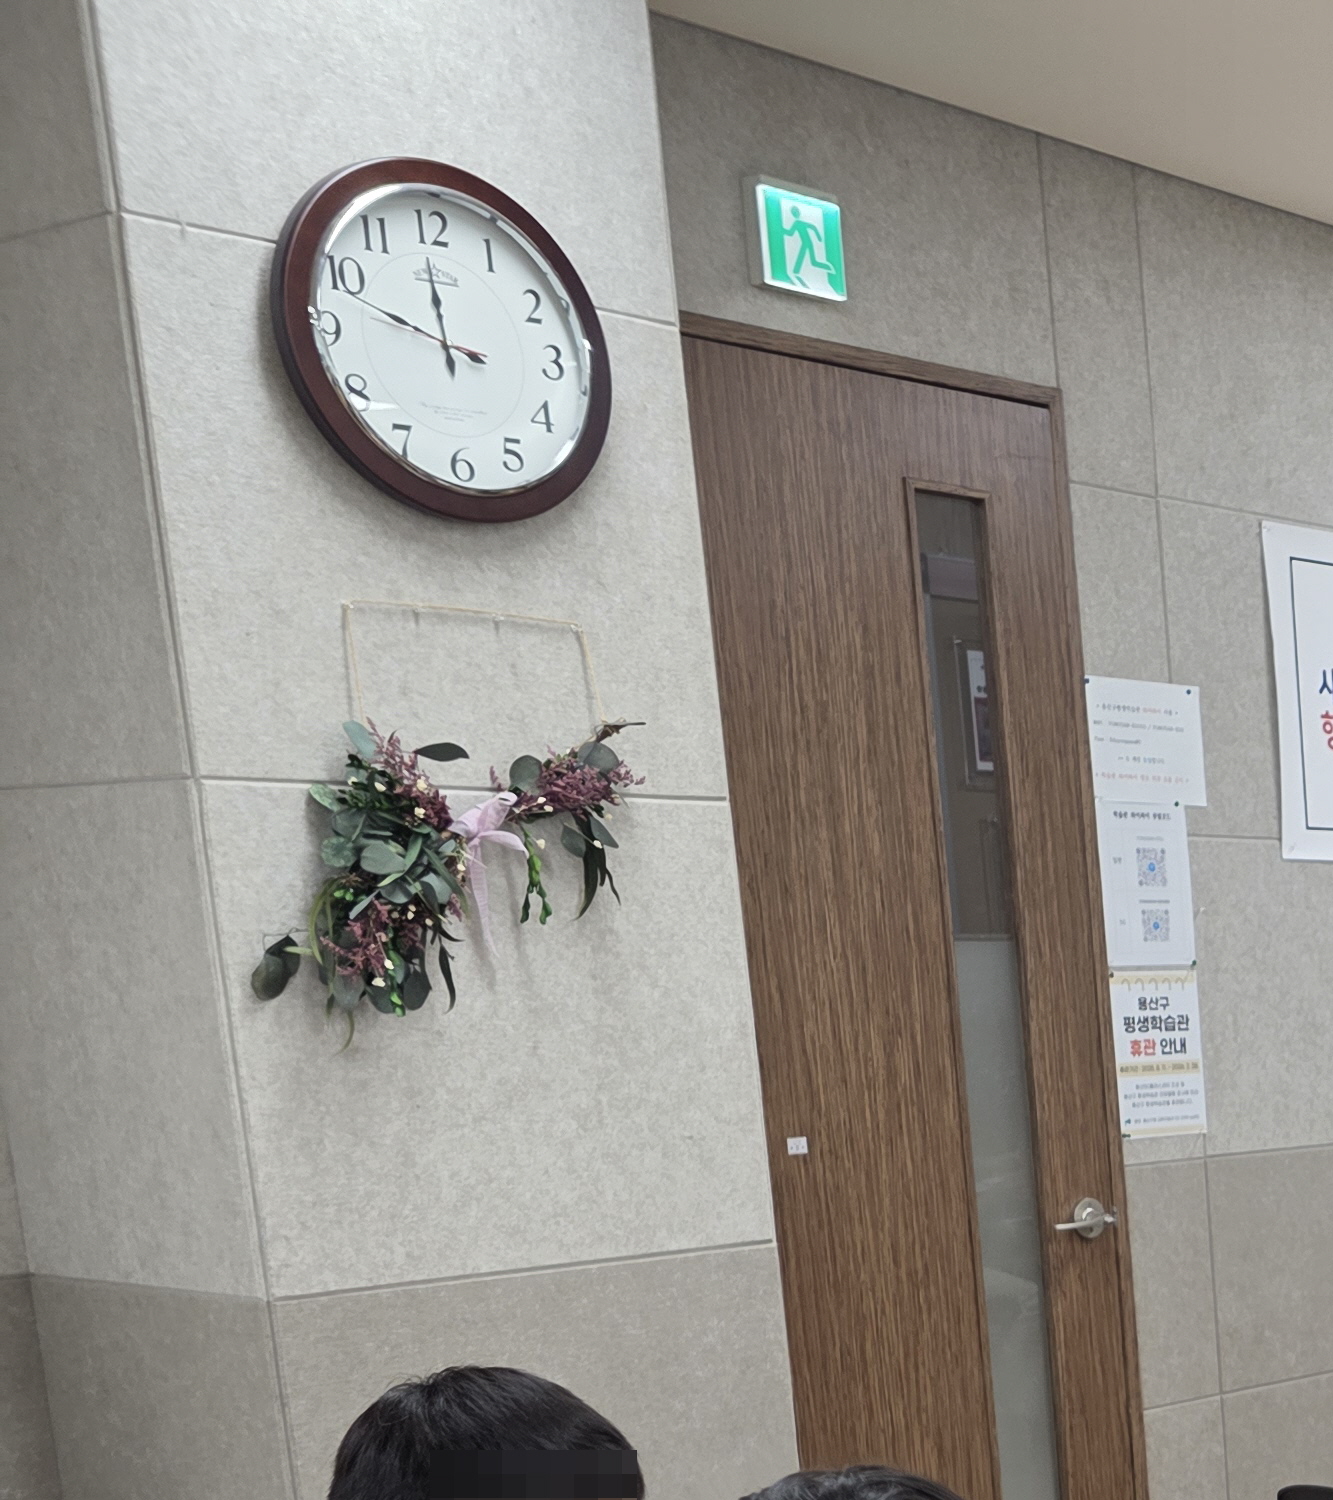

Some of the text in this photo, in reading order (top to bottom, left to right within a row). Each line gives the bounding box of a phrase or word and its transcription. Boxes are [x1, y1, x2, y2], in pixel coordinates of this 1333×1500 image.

[360, 213, 391, 255] 11
[414, 208, 449, 249] 12
[482, 238, 496, 274] 1
[327, 254, 366, 296] 10
[522, 288, 543, 326] 2
[320, 309, 342, 347] 9
[541, 344, 566, 381] 3
[344, 372, 371, 412] 8
[530, 399, 555, 434] 4
[391, 422, 413, 462] 7
[502, 436, 525, 473] 5
[450, 447, 476, 483] 6
[1137, 996, 1171, 1012] 용산구
[1122, 1013, 1191, 1034] 평생학습관
[1129, 1036, 1188, 1058] 휴관 안내
